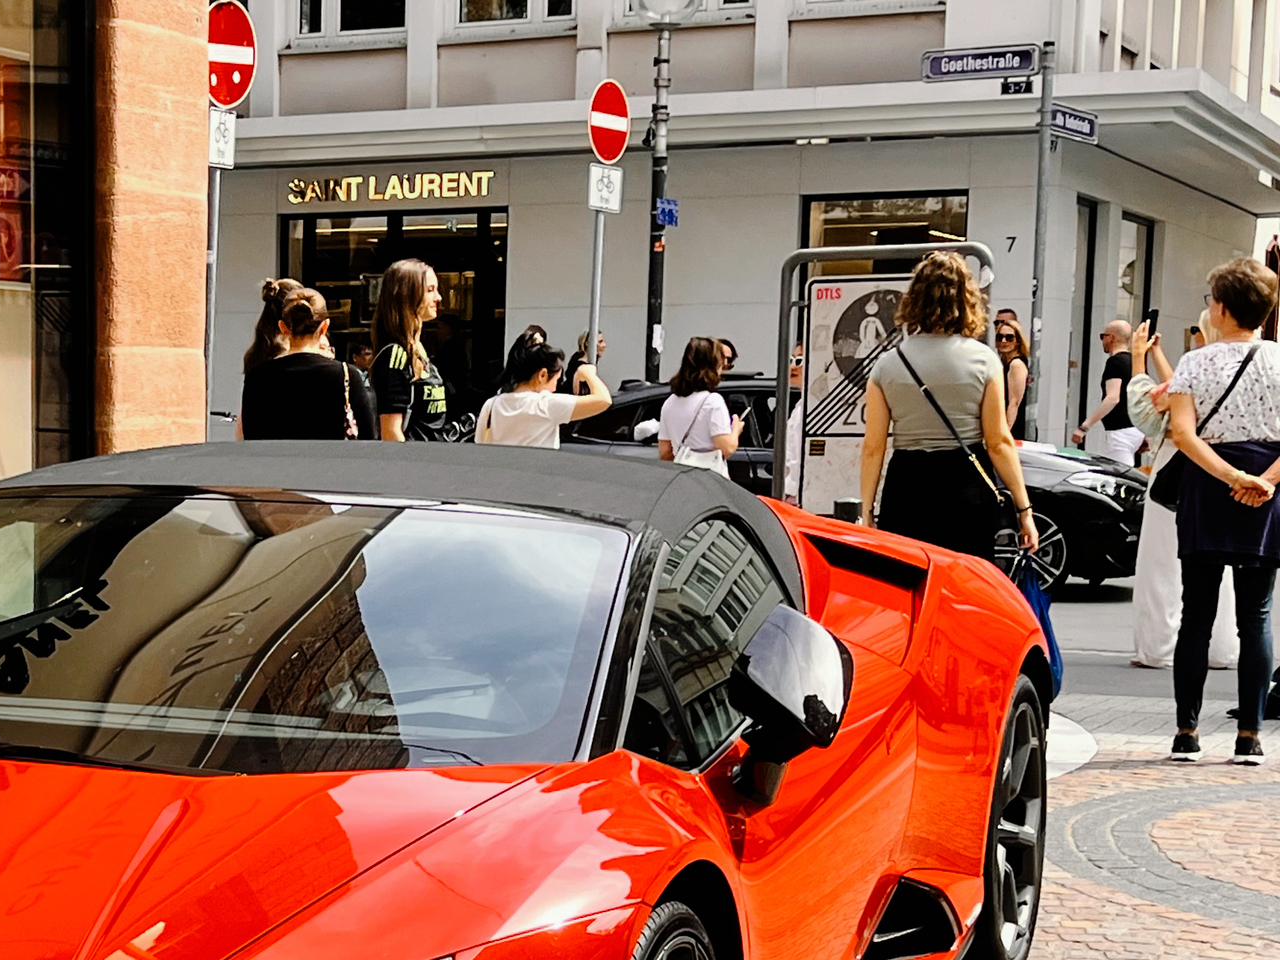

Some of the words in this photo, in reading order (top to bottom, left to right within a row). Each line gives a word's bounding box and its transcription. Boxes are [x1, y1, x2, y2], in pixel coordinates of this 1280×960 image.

[941, 53, 1020, 72] Goethestraße
[1009, 83, 1026, 93] 3-7
[288, 176, 363, 204] SAINT
[369, 171, 494, 200] LAURENT
[1006, 236, 1017, 253] 7
[817, 287, 841, 300] DTLS
